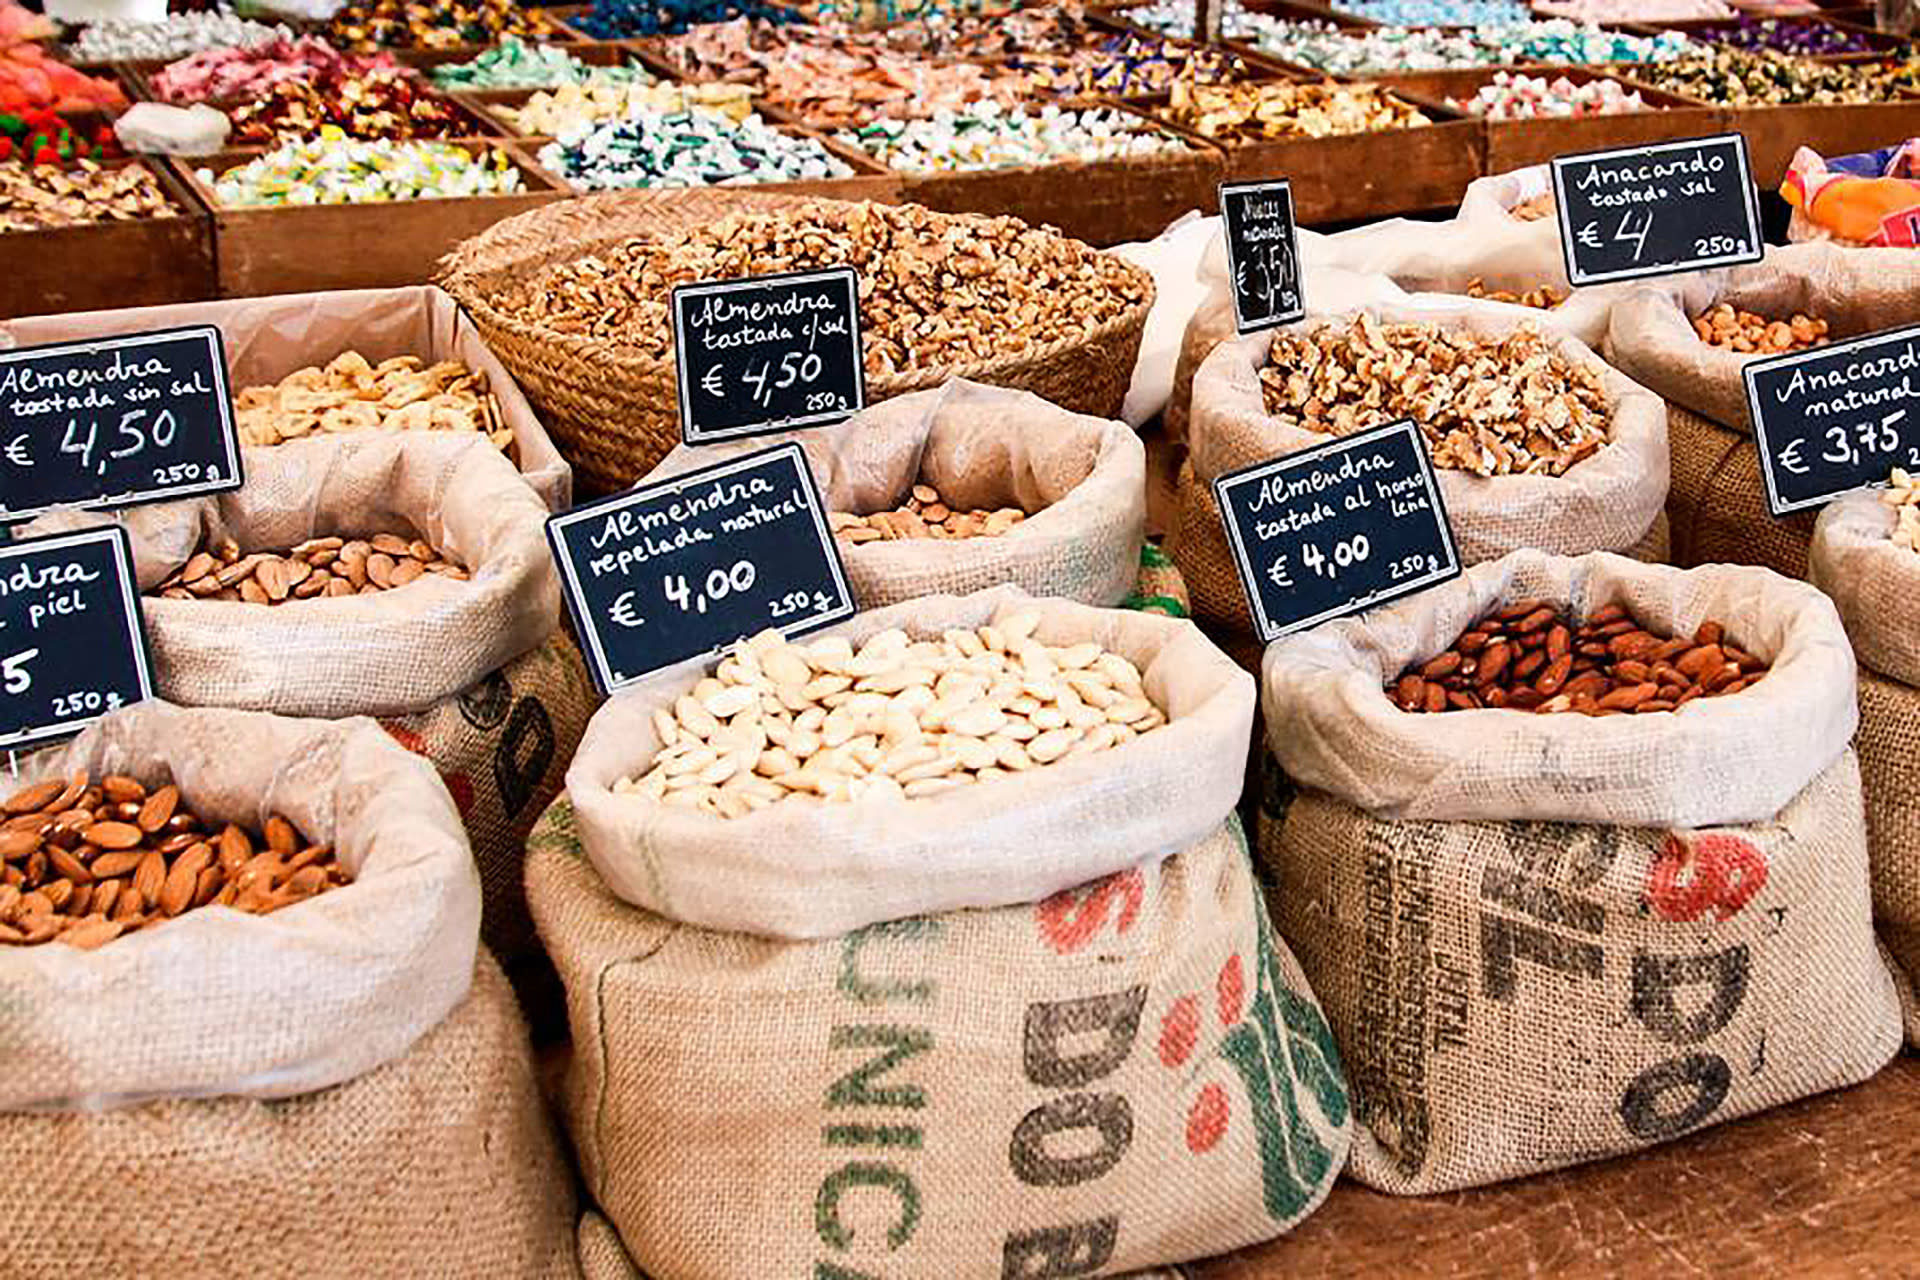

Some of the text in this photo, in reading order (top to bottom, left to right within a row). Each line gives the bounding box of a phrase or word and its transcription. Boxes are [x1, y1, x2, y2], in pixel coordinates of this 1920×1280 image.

[1577, 150, 1724, 190] Anacardo
[1681, 176, 1716, 197] sal
[1577, 210, 1653, 260] € 4
[691, 292, 836, 327] Almendra
[702, 322, 793, 349] tostada
[0, 351, 171, 396] Almendra
[10, 372, 211, 416] tostada sin sal
[701, 352, 822, 408] € 4,50
[1776, 343, 1920, 402] Anacard
[1805, 376, 1920, 416] natural
[4, 409, 176, 475] € 4,50
[1778, 409, 1906, 473] € 3,75
[1249, 453, 1394, 512] Almendra
[590, 477, 774, 548] Almendra
[590, 489, 808, 576] repelada natural
[1255, 502, 1336, 541] tostada
[1345, 484, 1371, 511] al
[1267, 534, 1370, 587] € 4,00
[29, 589, 86, 628] piel
[608, 560, 755, 627] € 4,00
[814, 919, 940, 1280] UNIC
